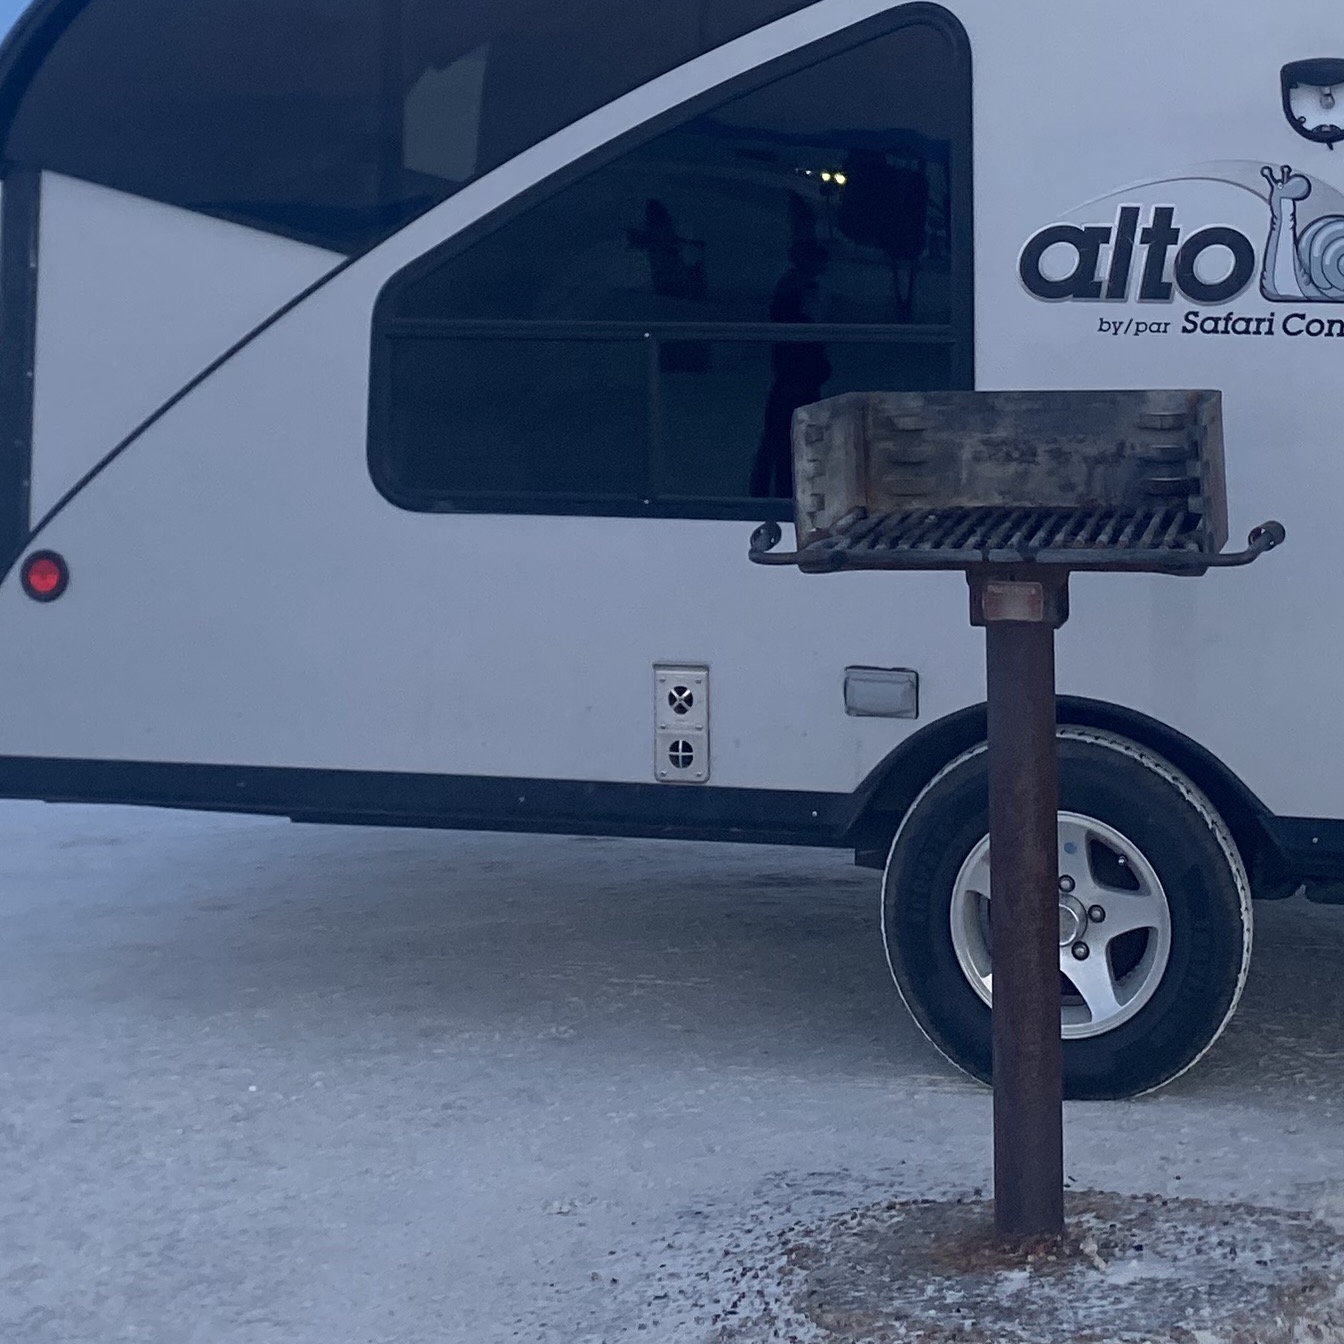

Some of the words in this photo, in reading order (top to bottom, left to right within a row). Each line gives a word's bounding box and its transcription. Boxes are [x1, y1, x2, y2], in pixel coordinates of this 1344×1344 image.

[1018, 205, 1256, 304] alto
[1097, 316, 1172, 337] by/par
[1180, 310, 1276, 337] Safari
